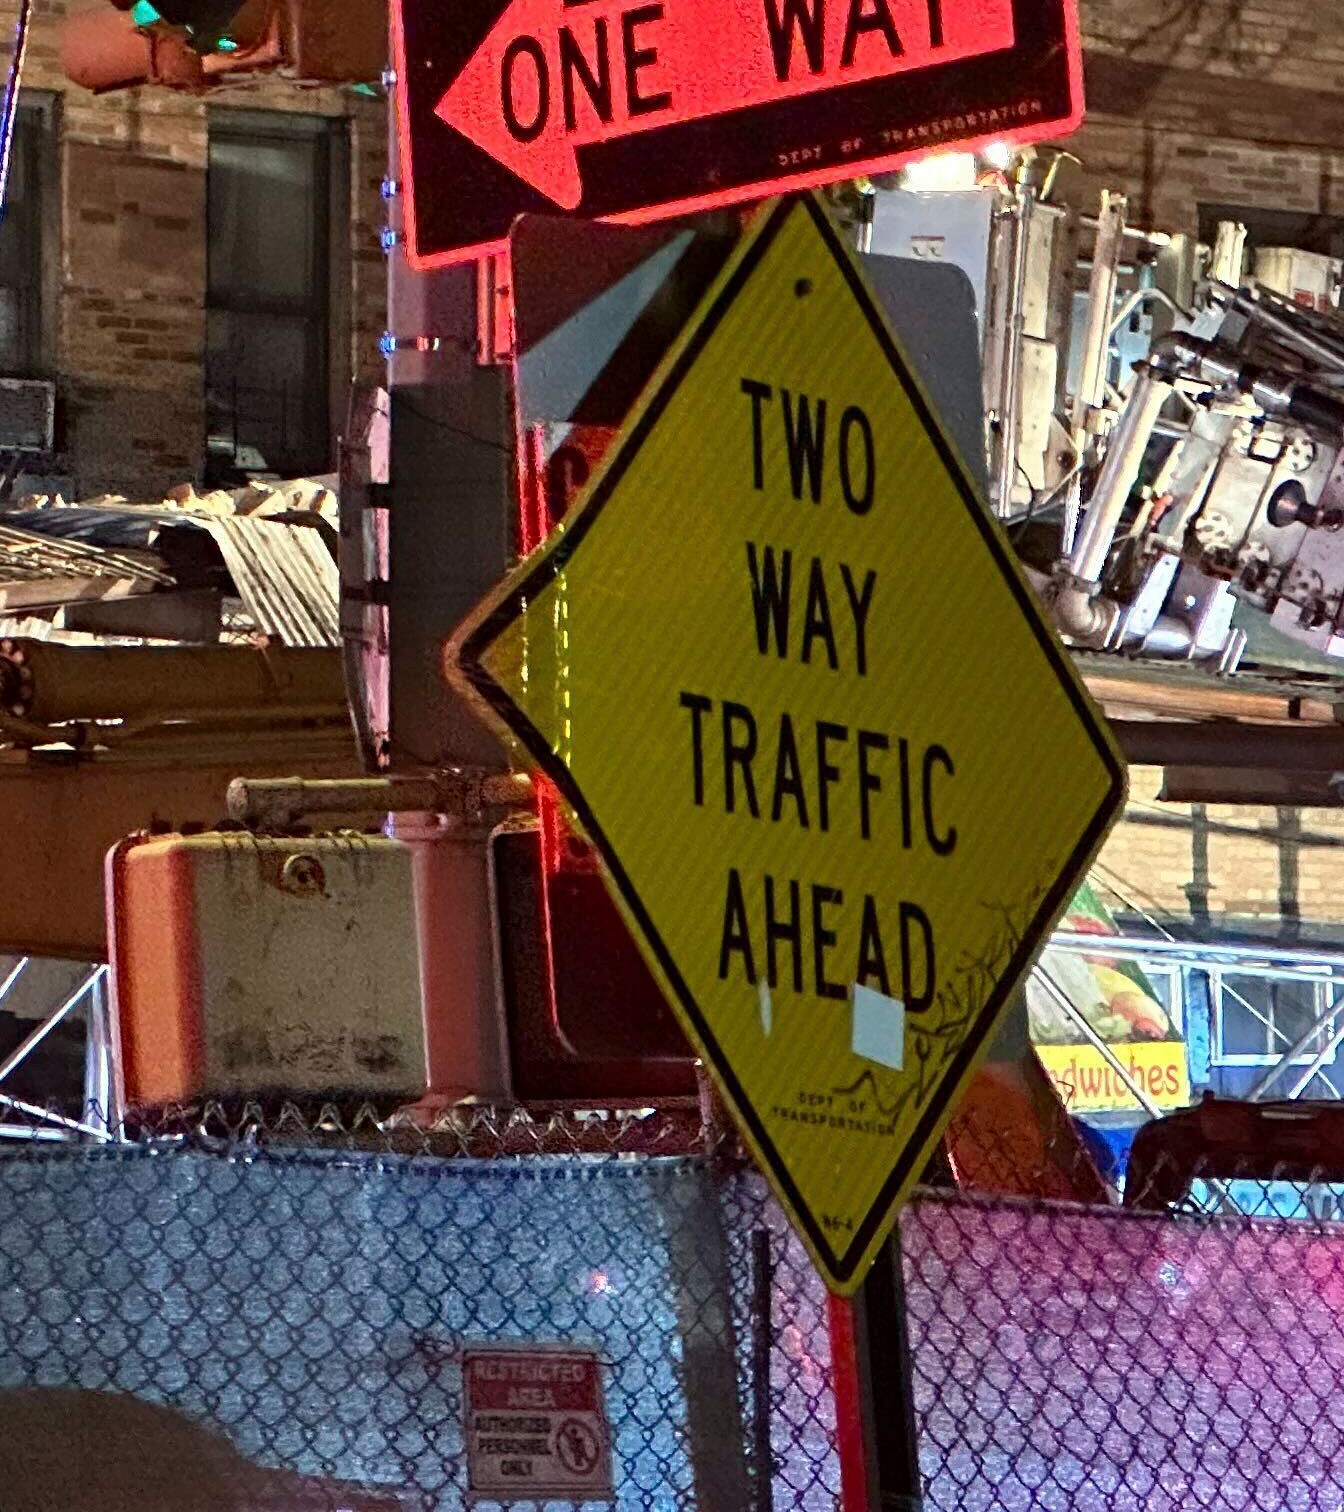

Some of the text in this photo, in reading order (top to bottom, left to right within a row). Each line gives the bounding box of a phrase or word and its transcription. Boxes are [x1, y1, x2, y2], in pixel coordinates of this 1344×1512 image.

[501, 3, 672, 144] ONE
[778, 100, 1043, 166] DEPT OF TRANSPORTATION
[740, 377, 876, 516] TWO
[746, 541, 877, 676] WAY
[680, 691, 957, 857] TRAFFIC
[718, 867, 935, 1013] AHEAD
[773, 1106, 895, 1136] TRANSPORTATION
[799, 1093, 866, 1114] DEPT OF
[474, 1360, 586, 1383] RESTRICTED
[507, 1388, 557, 1408] AREA
